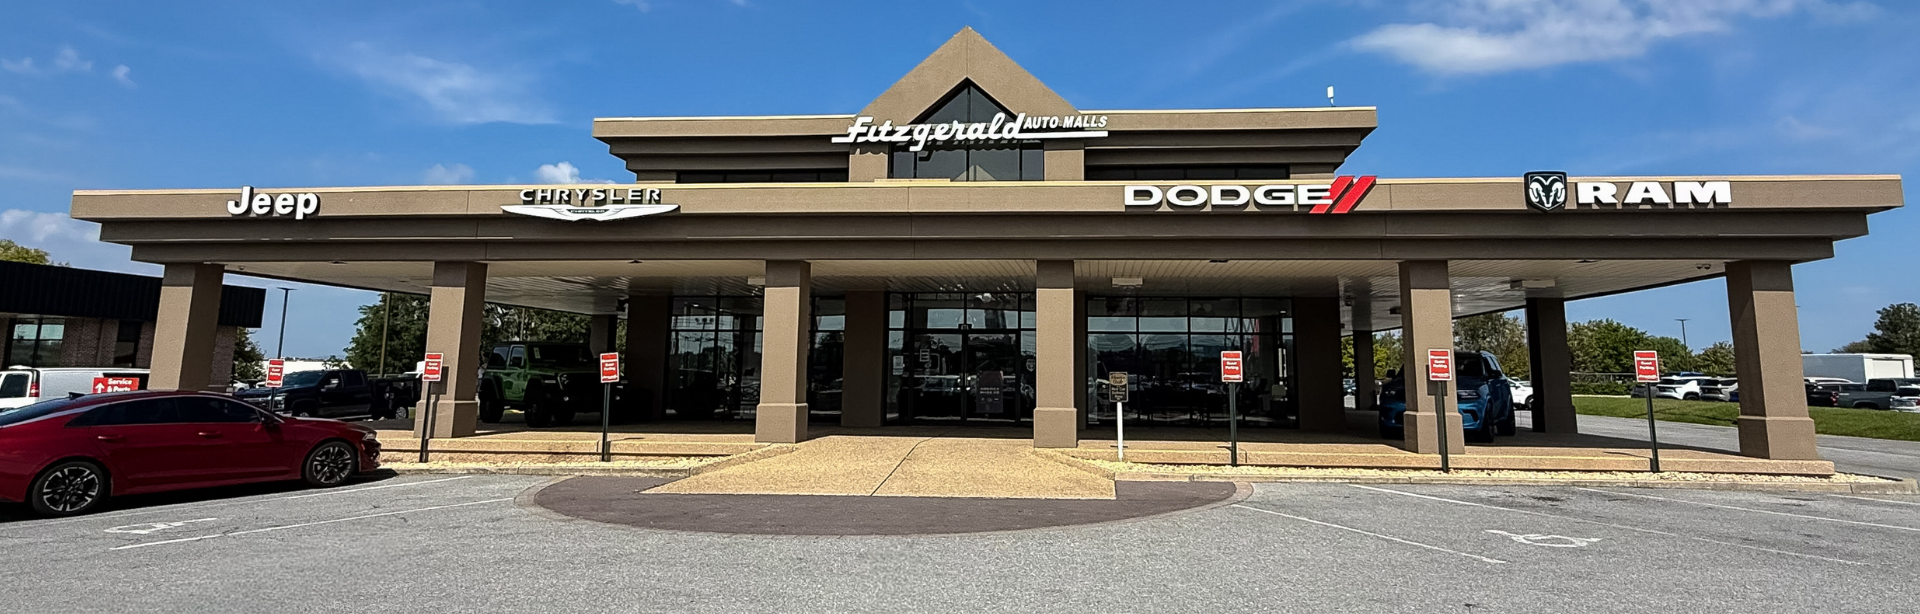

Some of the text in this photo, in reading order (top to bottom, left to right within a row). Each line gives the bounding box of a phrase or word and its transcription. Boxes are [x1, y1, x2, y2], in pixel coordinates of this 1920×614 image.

[832, 113, 1108, 151] Fitzgerald AUTO MALLS
[227, 185, 318, 220] Jeep
[519, 188, 661, 201] CHRYSLER
[1124, 184, 1333, 206] DODGE
[1577, 181, 1732, 204] RAM
